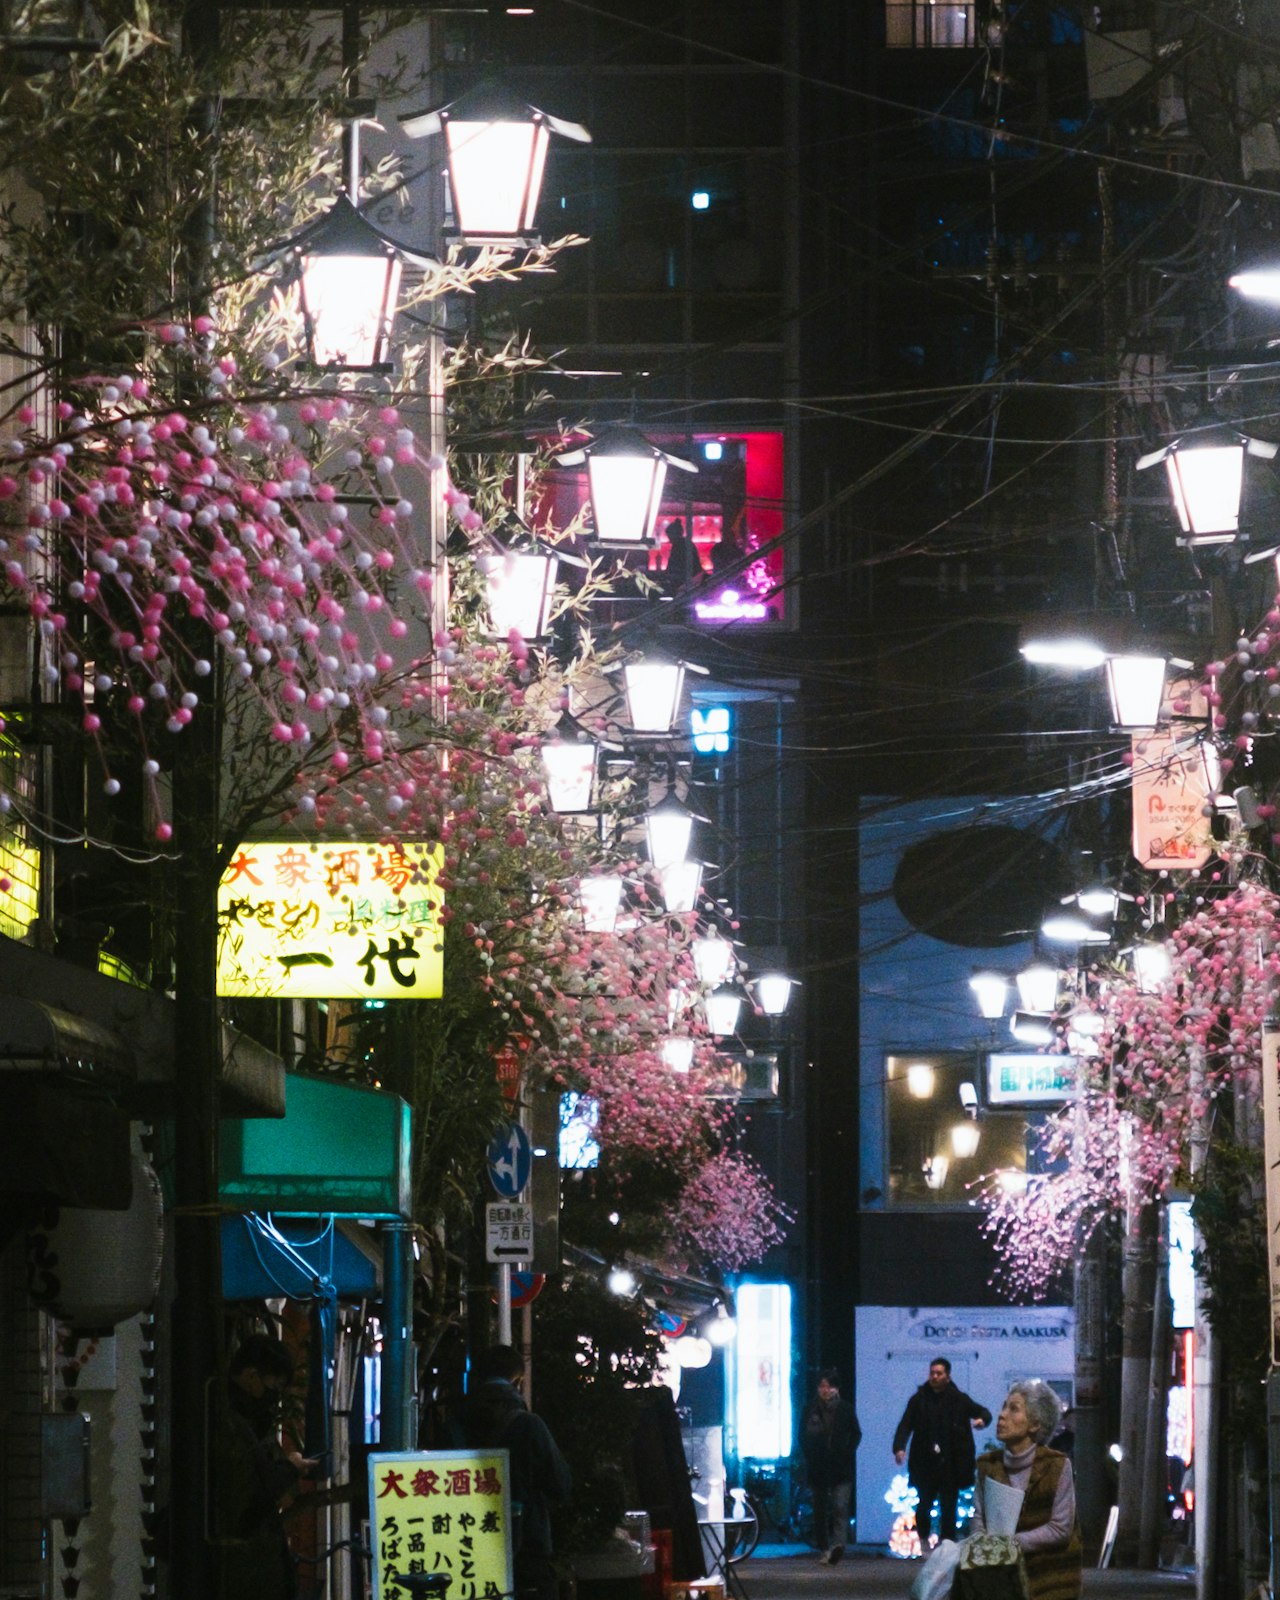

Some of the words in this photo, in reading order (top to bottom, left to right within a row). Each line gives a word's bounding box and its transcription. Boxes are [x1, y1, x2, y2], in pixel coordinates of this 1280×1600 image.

[222, 847, 413, 891] 大衆酒場
[277, 931, 421, 988] 一代
[489, 1225, 531, 1242] 一方通行
[1011, 1325, 1067, 1338] ASAKUSA
[377, 1467, 502, 1499] 大衆酒場
